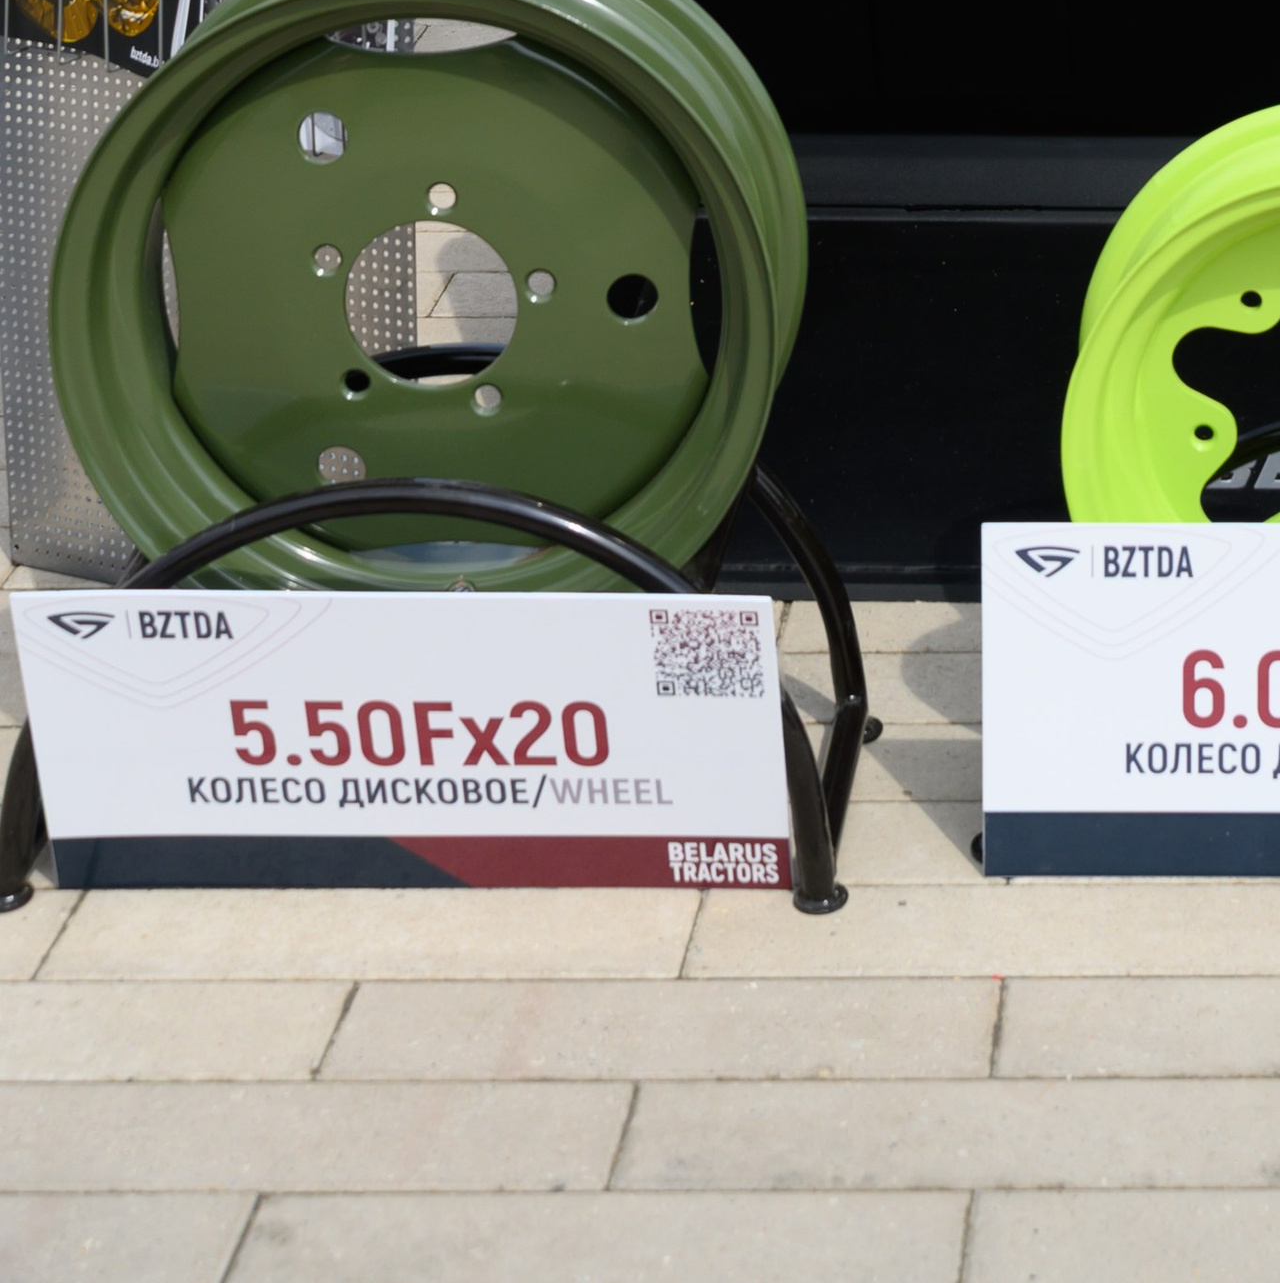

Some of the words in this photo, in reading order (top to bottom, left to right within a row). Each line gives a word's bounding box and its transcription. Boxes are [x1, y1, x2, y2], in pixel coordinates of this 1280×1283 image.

[1104, 546, 1193, 578] BZTDA
[140, 611, 234, 640] BZTDA
[229, 700, 611, 768] 5.50Fx20
[1125, 743, 1261, 775] КОЛЕСО
[188, 776, 327, 806] КОЛЕСО
[338, 775, 674, 809] ДИСКОВОЕ/WHEEL
[668, 842, 778, 864] BELARUS
[669, 862, 779, 884] TRACTORS
